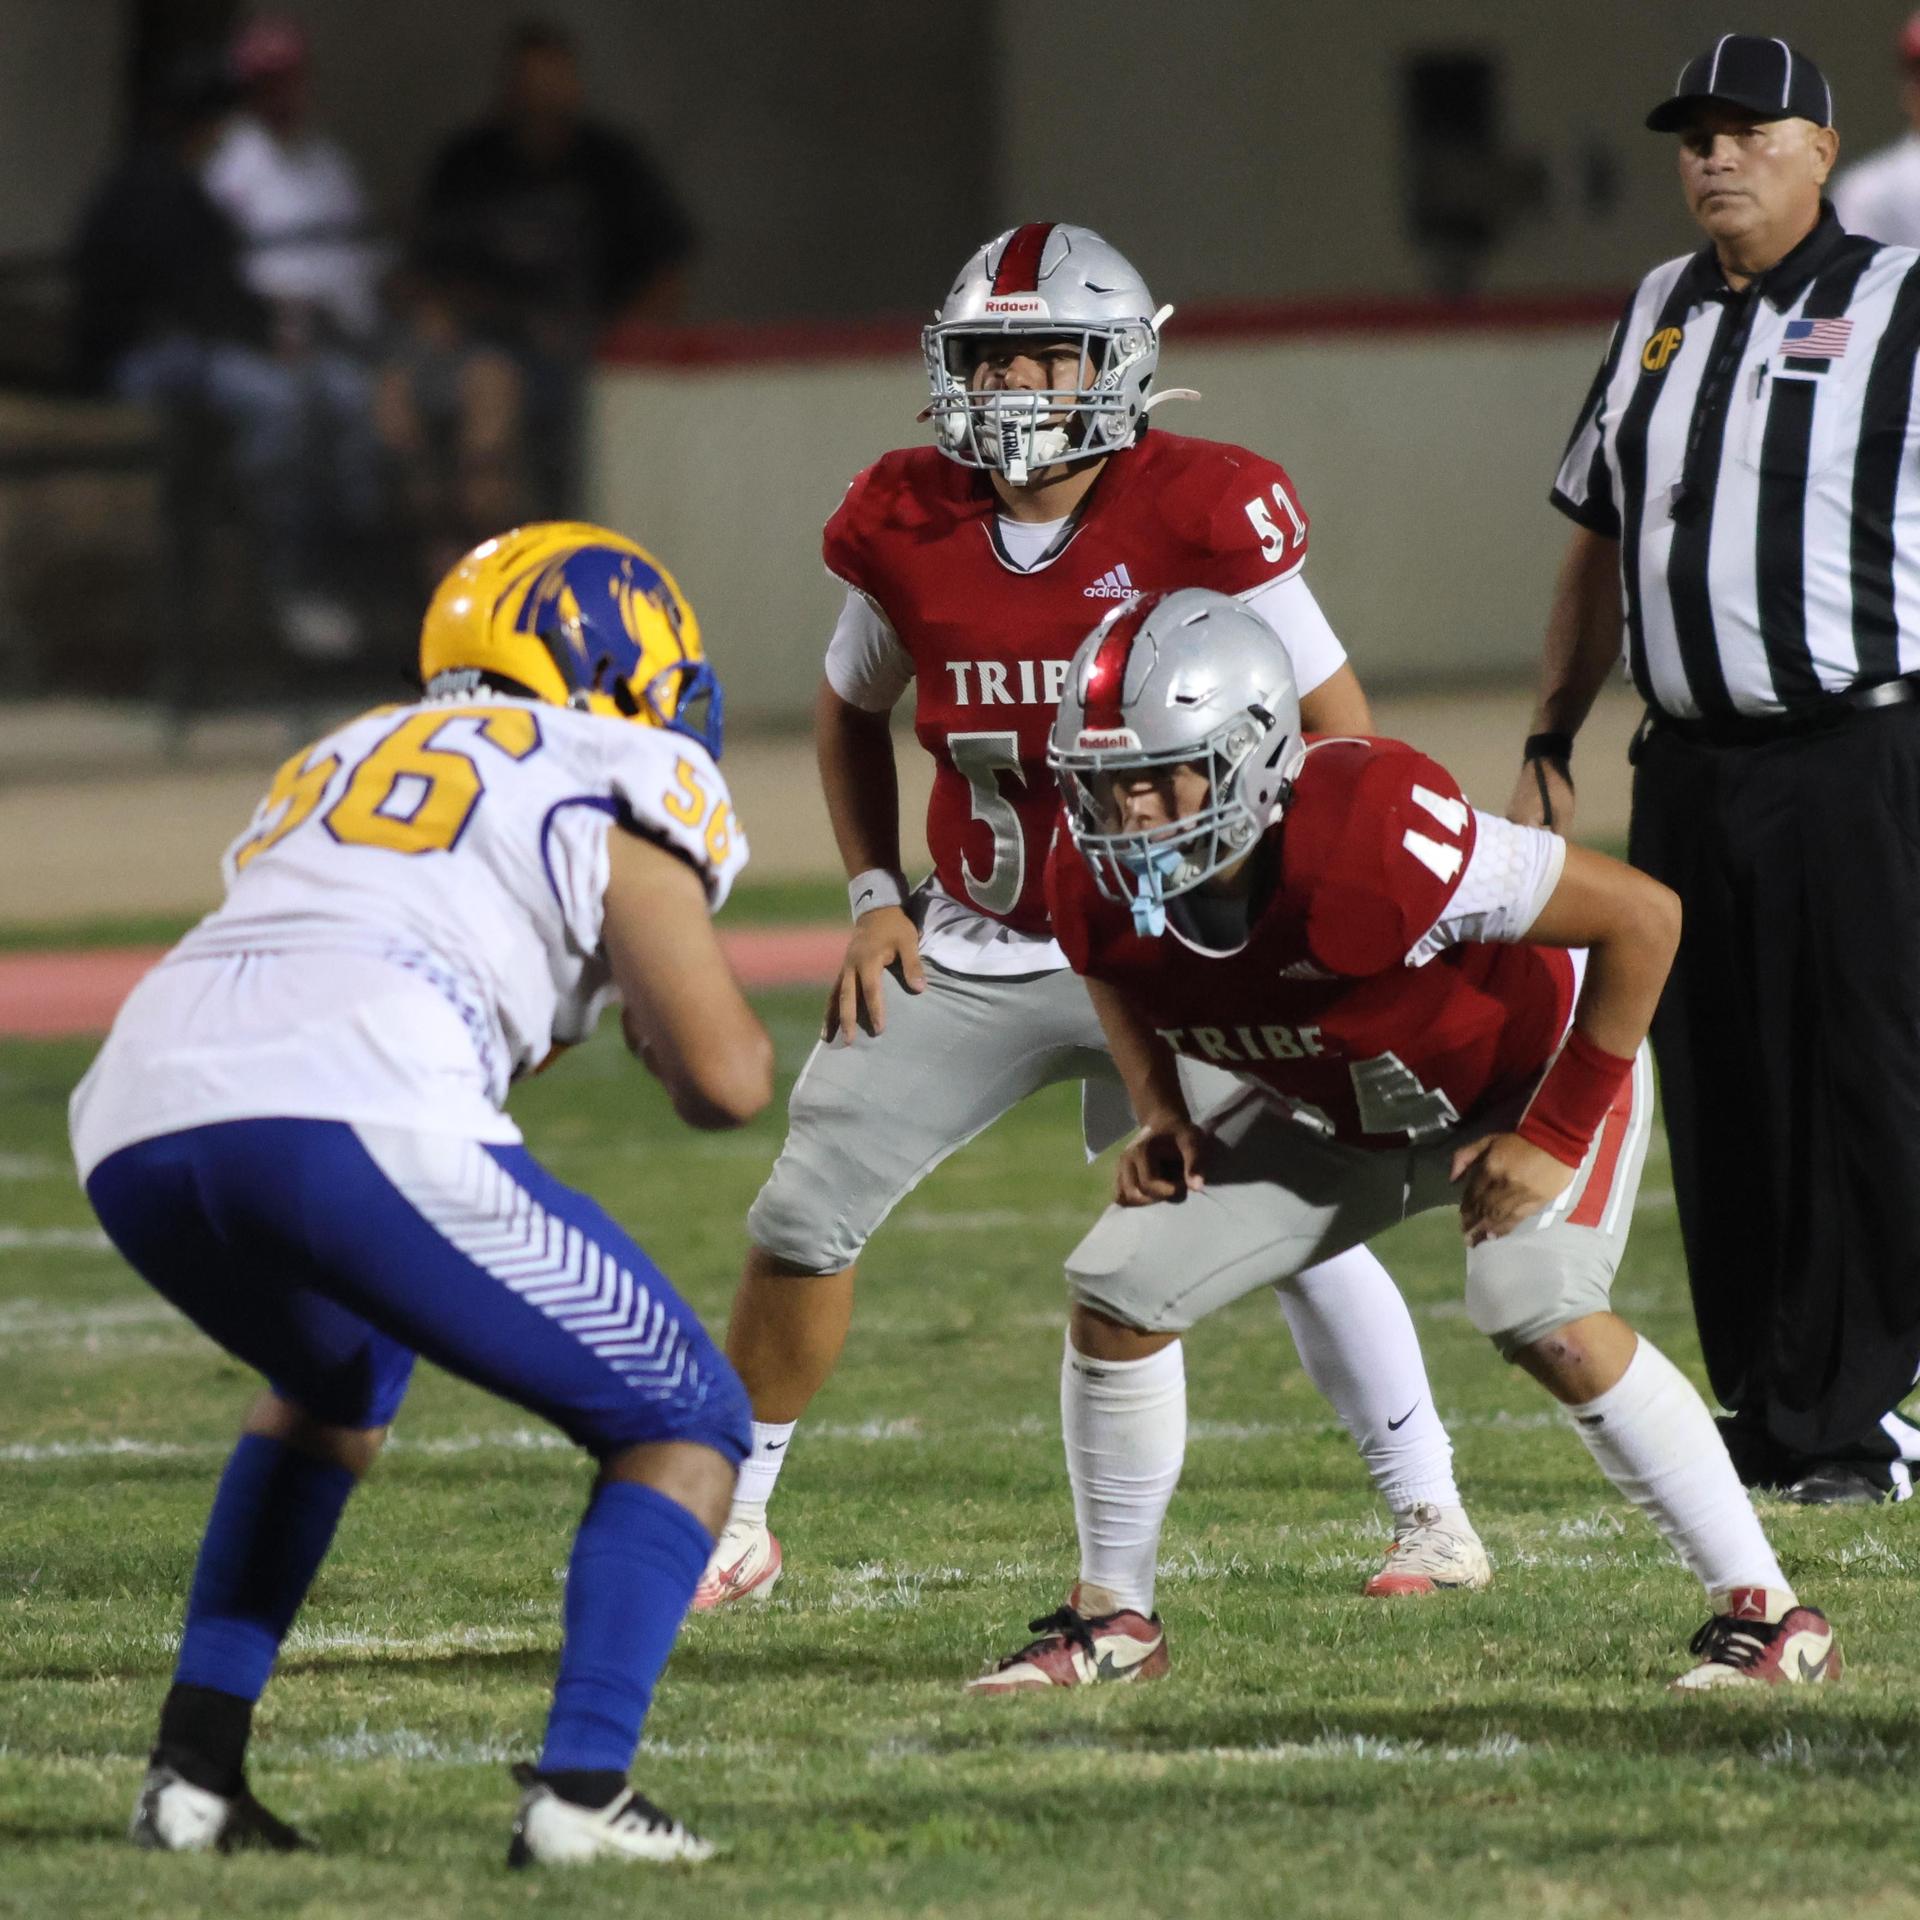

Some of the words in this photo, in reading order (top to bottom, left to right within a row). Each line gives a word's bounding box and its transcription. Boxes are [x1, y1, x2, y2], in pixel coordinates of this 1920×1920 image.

[984, 301, 1039, 313] Riddell
[1642, 327, 1682, 371] CIF
[1245, 483, 1306, 563] 52
[1083, 585, 1140, 599] adidas
[945, 660, 1072, 705] TRIB
[1079, 735, 1129, 749] Riddell
[947, 731, 1059, 921] 5
